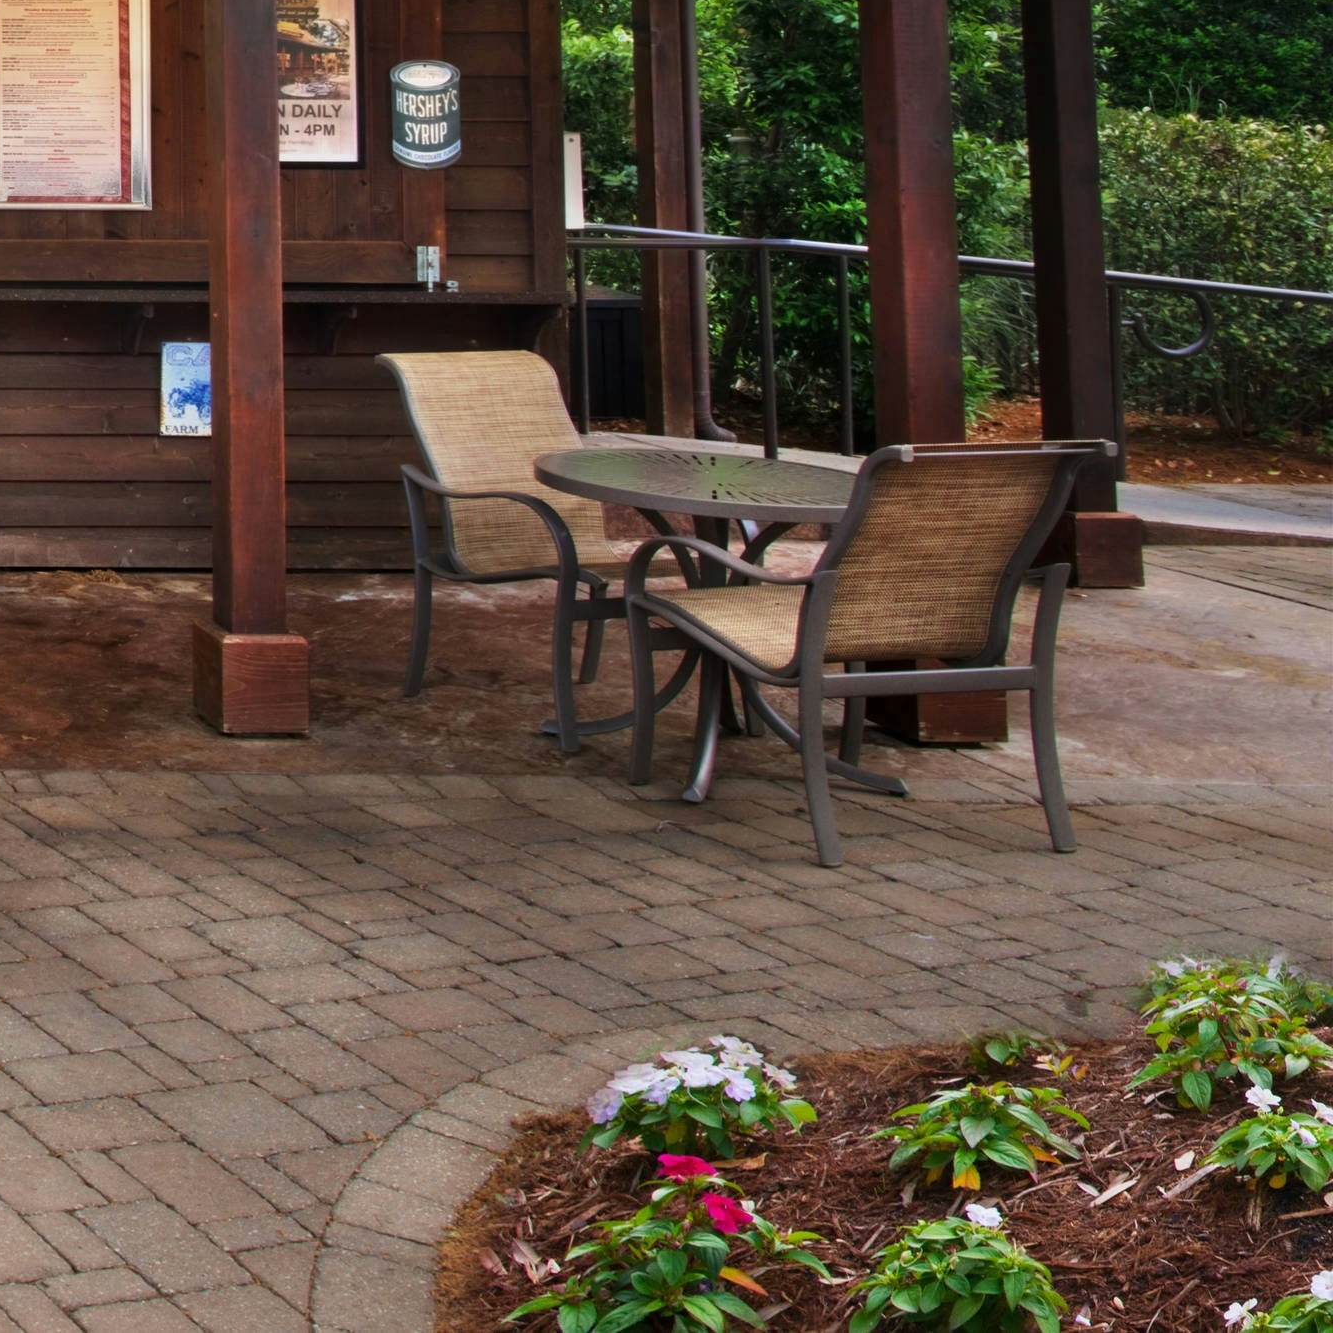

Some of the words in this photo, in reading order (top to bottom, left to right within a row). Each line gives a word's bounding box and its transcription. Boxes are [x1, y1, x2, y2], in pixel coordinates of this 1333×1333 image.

[395, 87, 459, 118] HERSHEY'S
[291, 104, 343, 118] DAILY
[303, 124, 335, 136] 4PM
[405, 122, 448, 145] SYRUP
[165, 425, 199, 434] FARM
